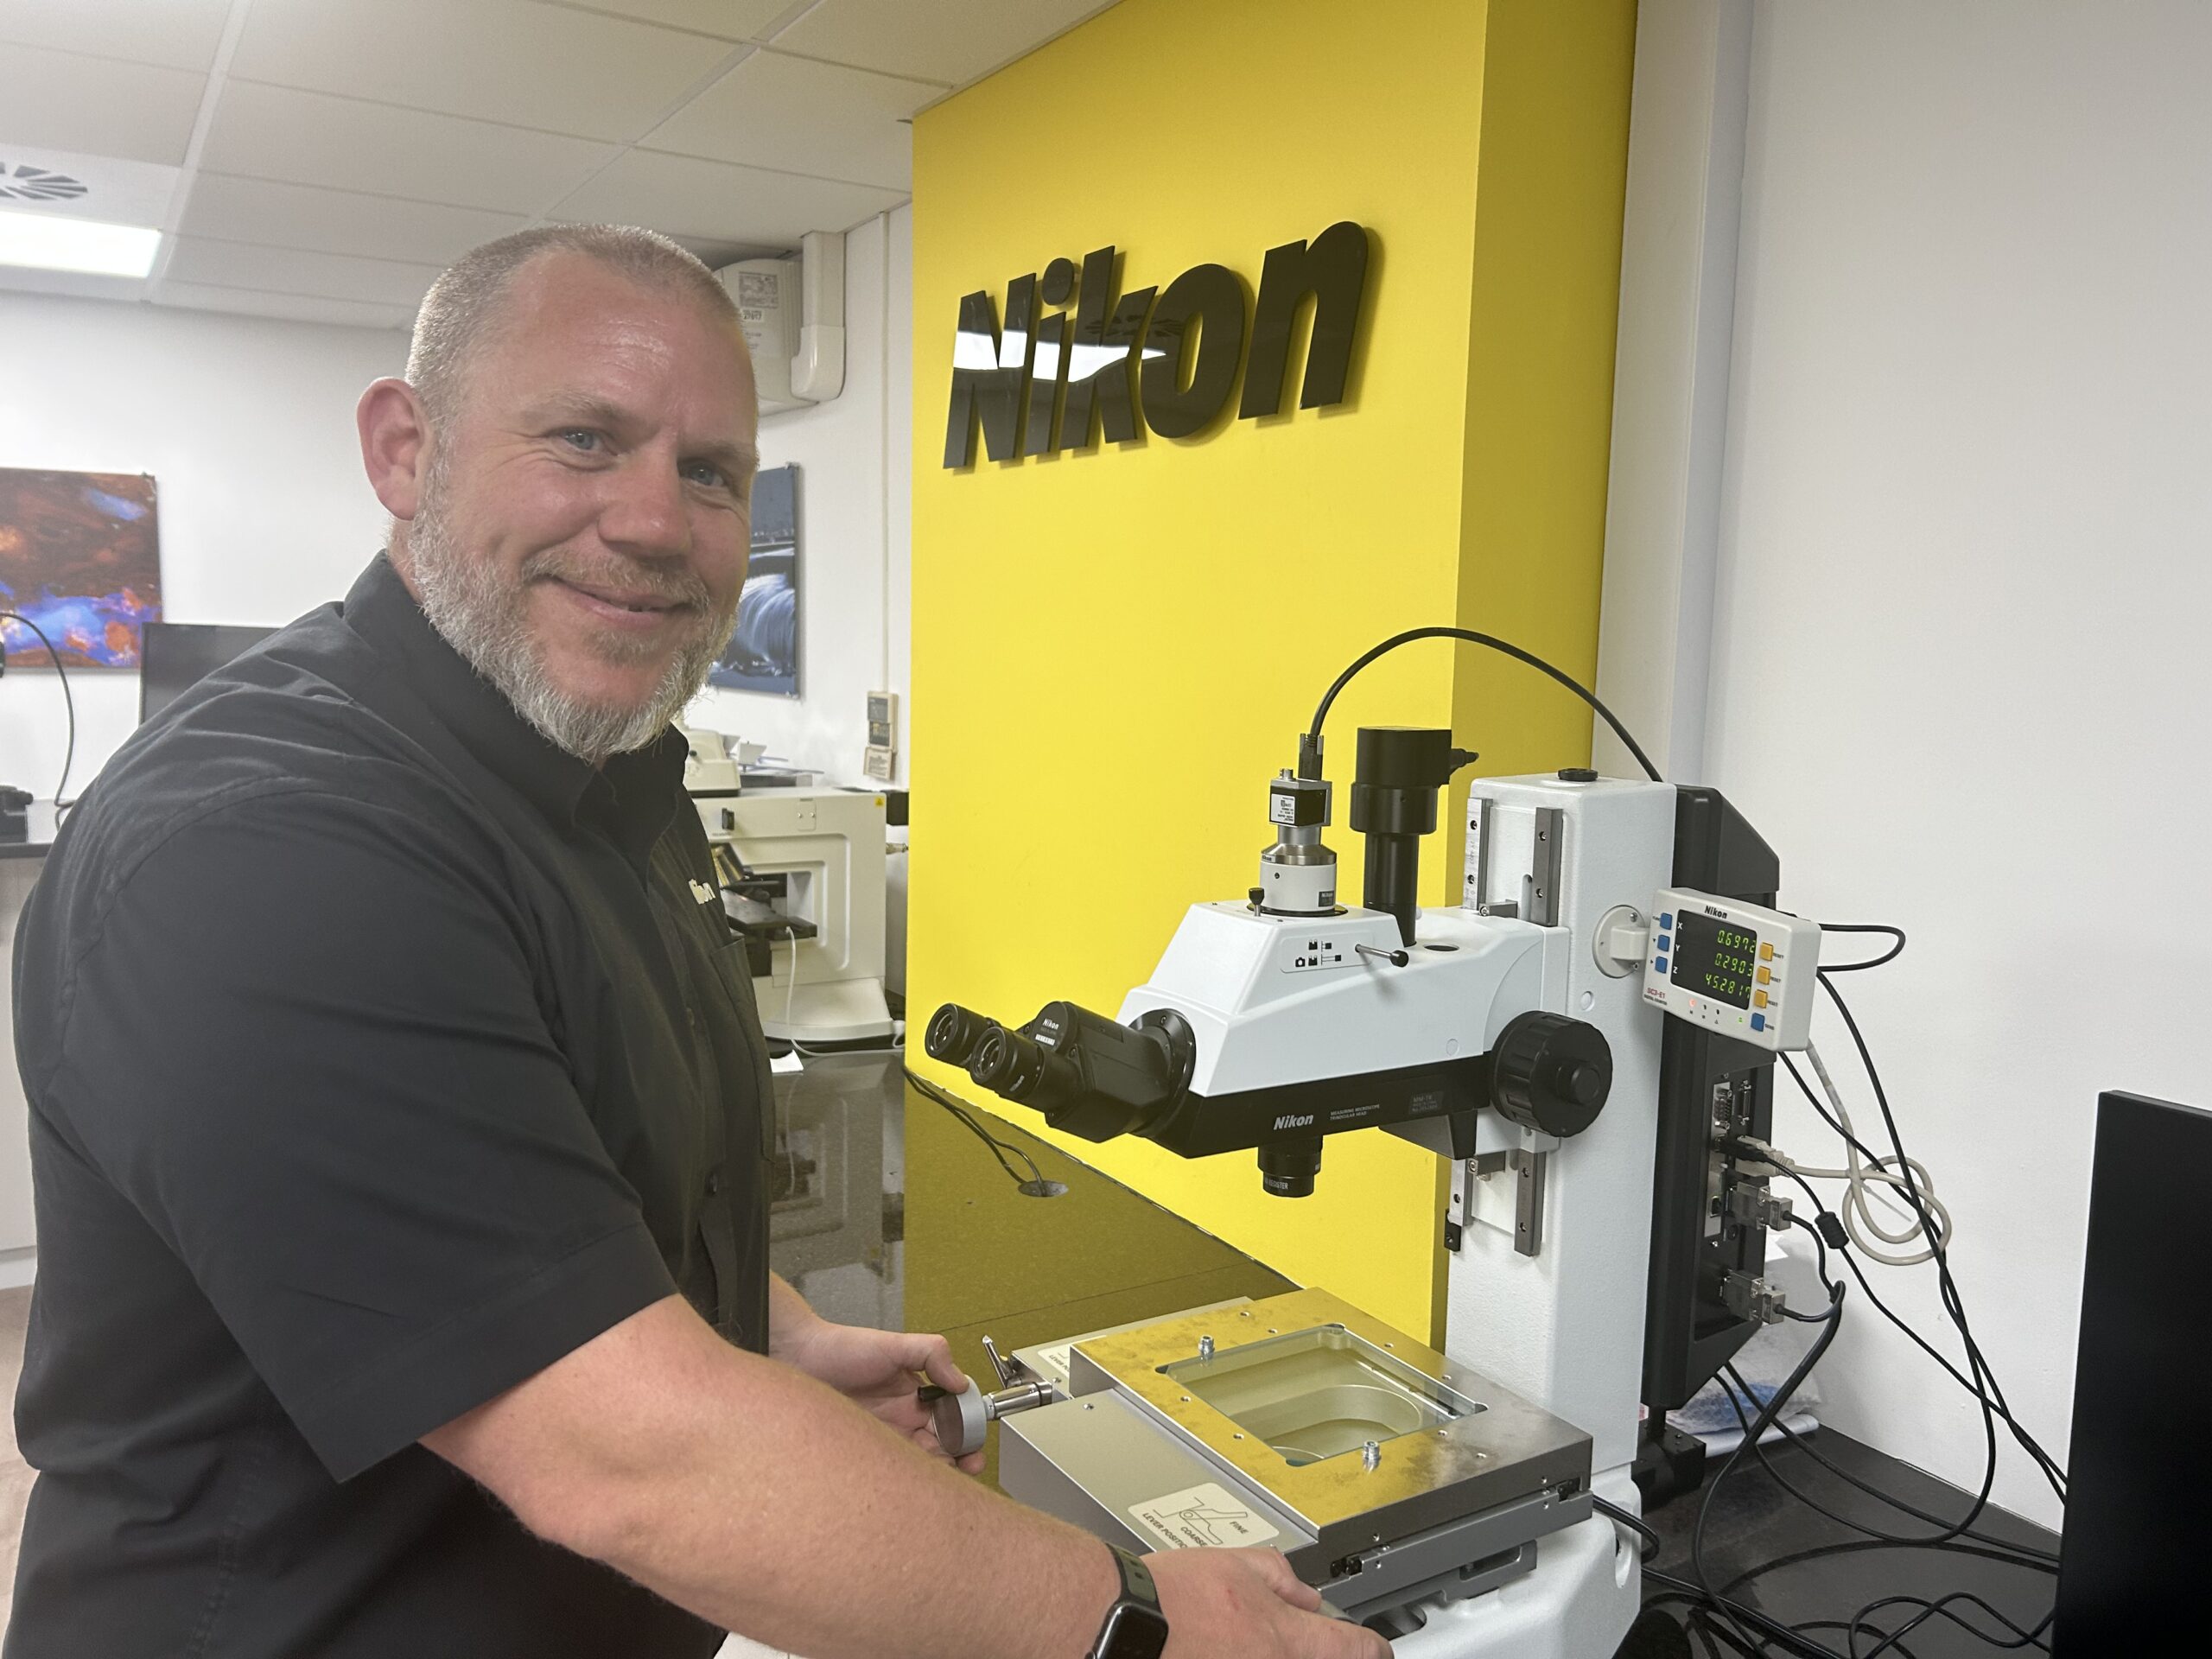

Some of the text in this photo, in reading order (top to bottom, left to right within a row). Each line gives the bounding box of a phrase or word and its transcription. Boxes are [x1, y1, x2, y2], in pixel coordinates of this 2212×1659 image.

[943, 221, 1369, 469] Nikon
[1704, 905, 1728, 919] Nikon
[1675, 944, 1681, 952] Y
[1042, 1018, 1059, 1030] Nikon
[1273, 1113, 1314, 1131] Nikon
[1142, 1512, 1188, 1548] LEVER POSITIO
[1229, 1521, 1249, 1534] FINE
[1180, 1526, 1208, 1548] COARSE
